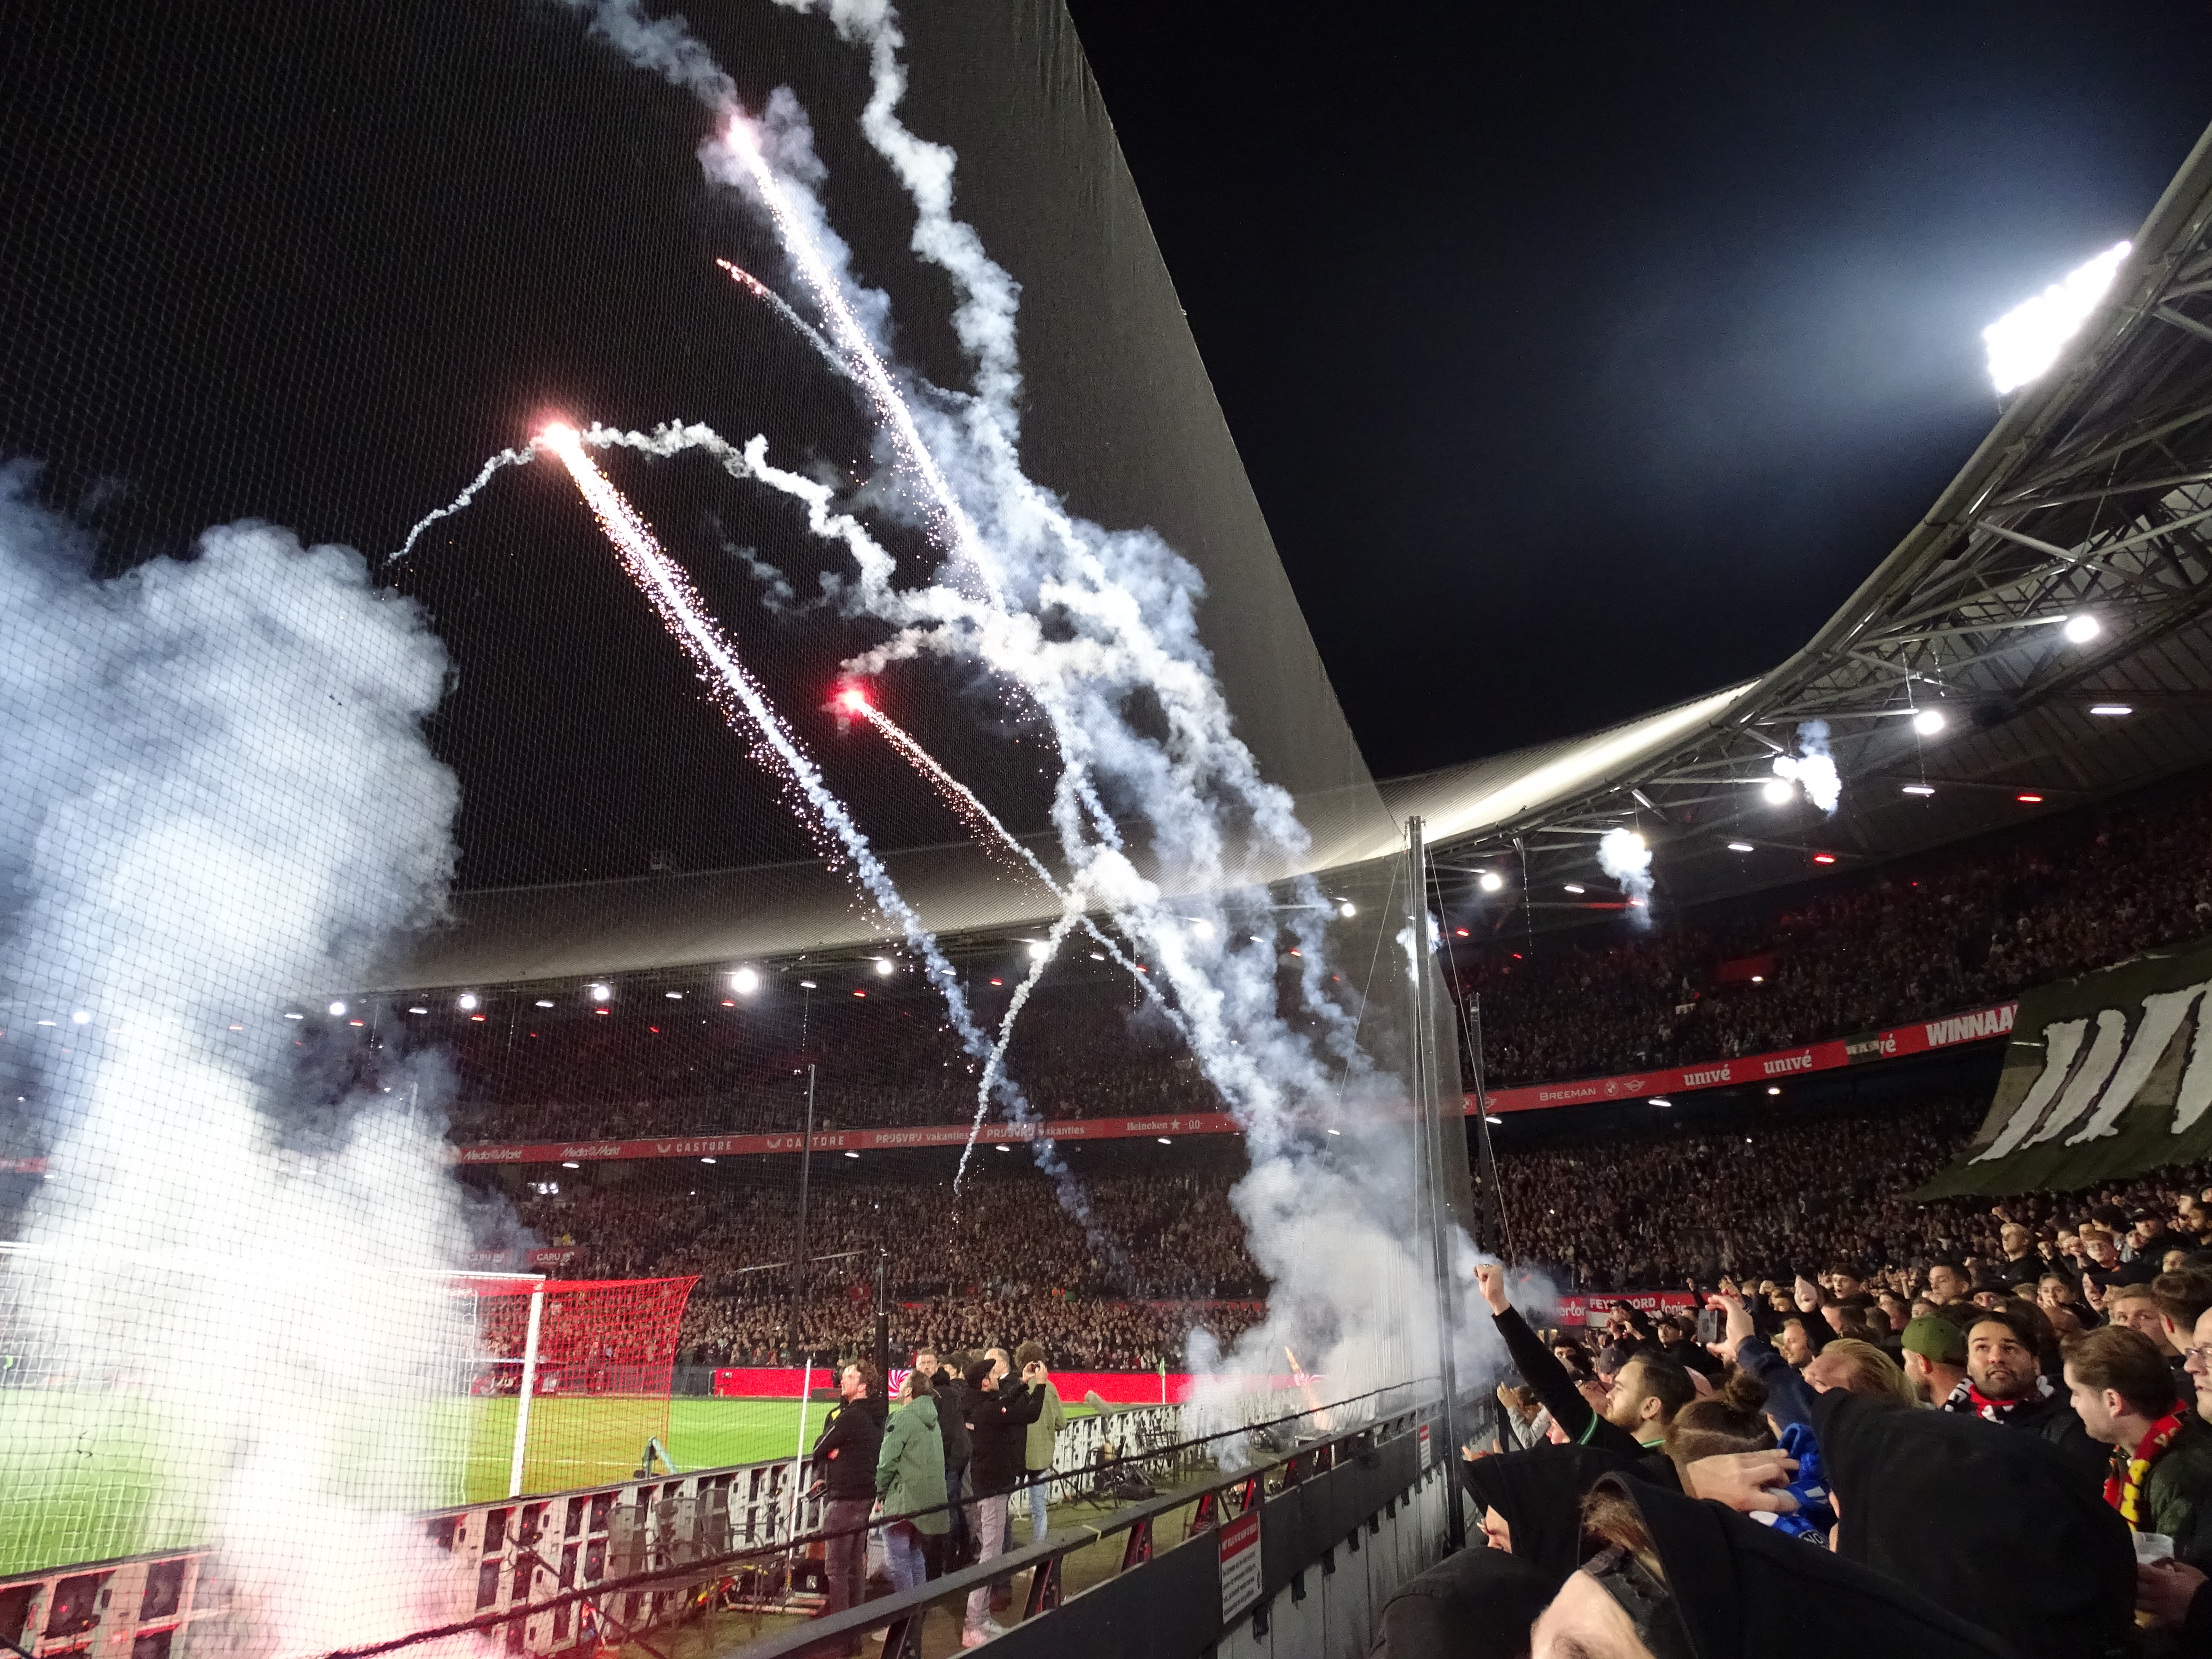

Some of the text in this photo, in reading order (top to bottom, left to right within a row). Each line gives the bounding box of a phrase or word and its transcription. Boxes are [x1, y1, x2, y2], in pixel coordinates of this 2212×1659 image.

[1764, 1050, 1812, 1074] univé
[1683, 1064, 1731, 1086] univé
[1540, 1087, 1596, 1101] BREEMAN
[1127, 1121, 1168, 1131] Heineken
[676, 1140, 732, 1153] CASTORE
[786, 1135, 844, 1148] CATORE
